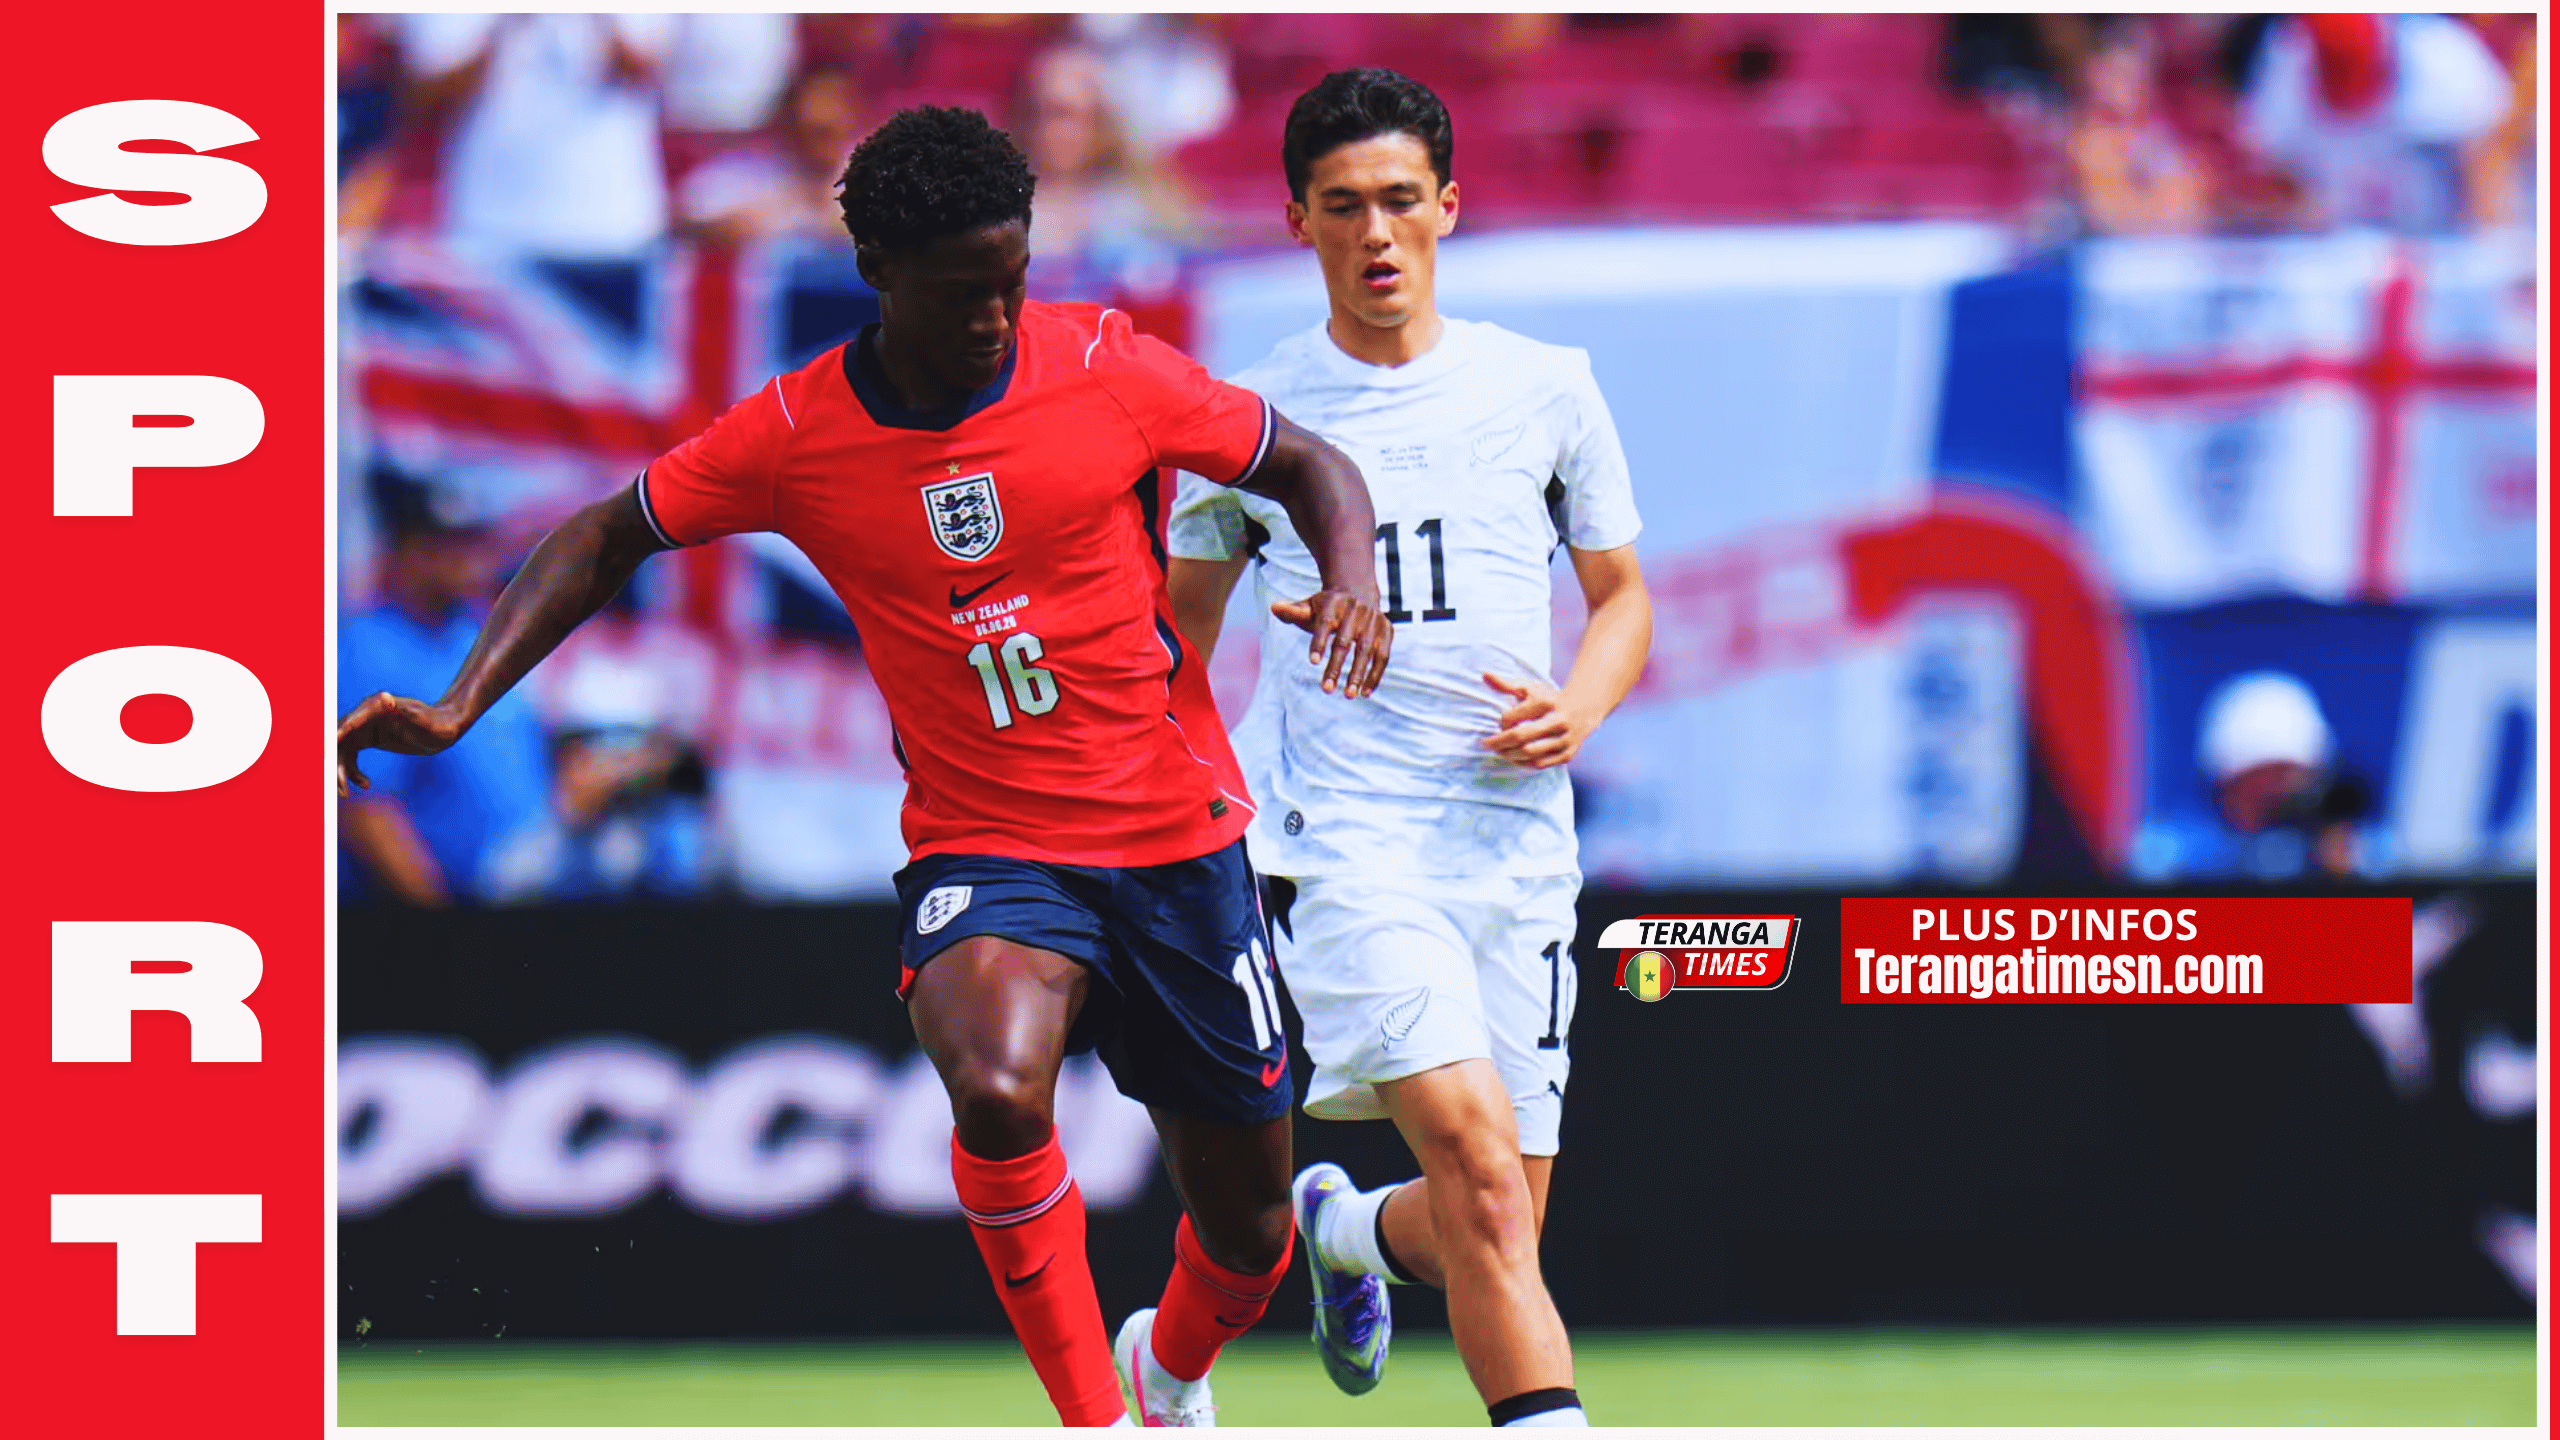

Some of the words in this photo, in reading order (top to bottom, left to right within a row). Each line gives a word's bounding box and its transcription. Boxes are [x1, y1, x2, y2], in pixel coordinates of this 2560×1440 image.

[950, 610, 976, 626] NEW
[977, 594, 1030, 620] ZEALAND
[1374, 518, 1456, 624] 11
[966, 632, 1059, 729] 16
